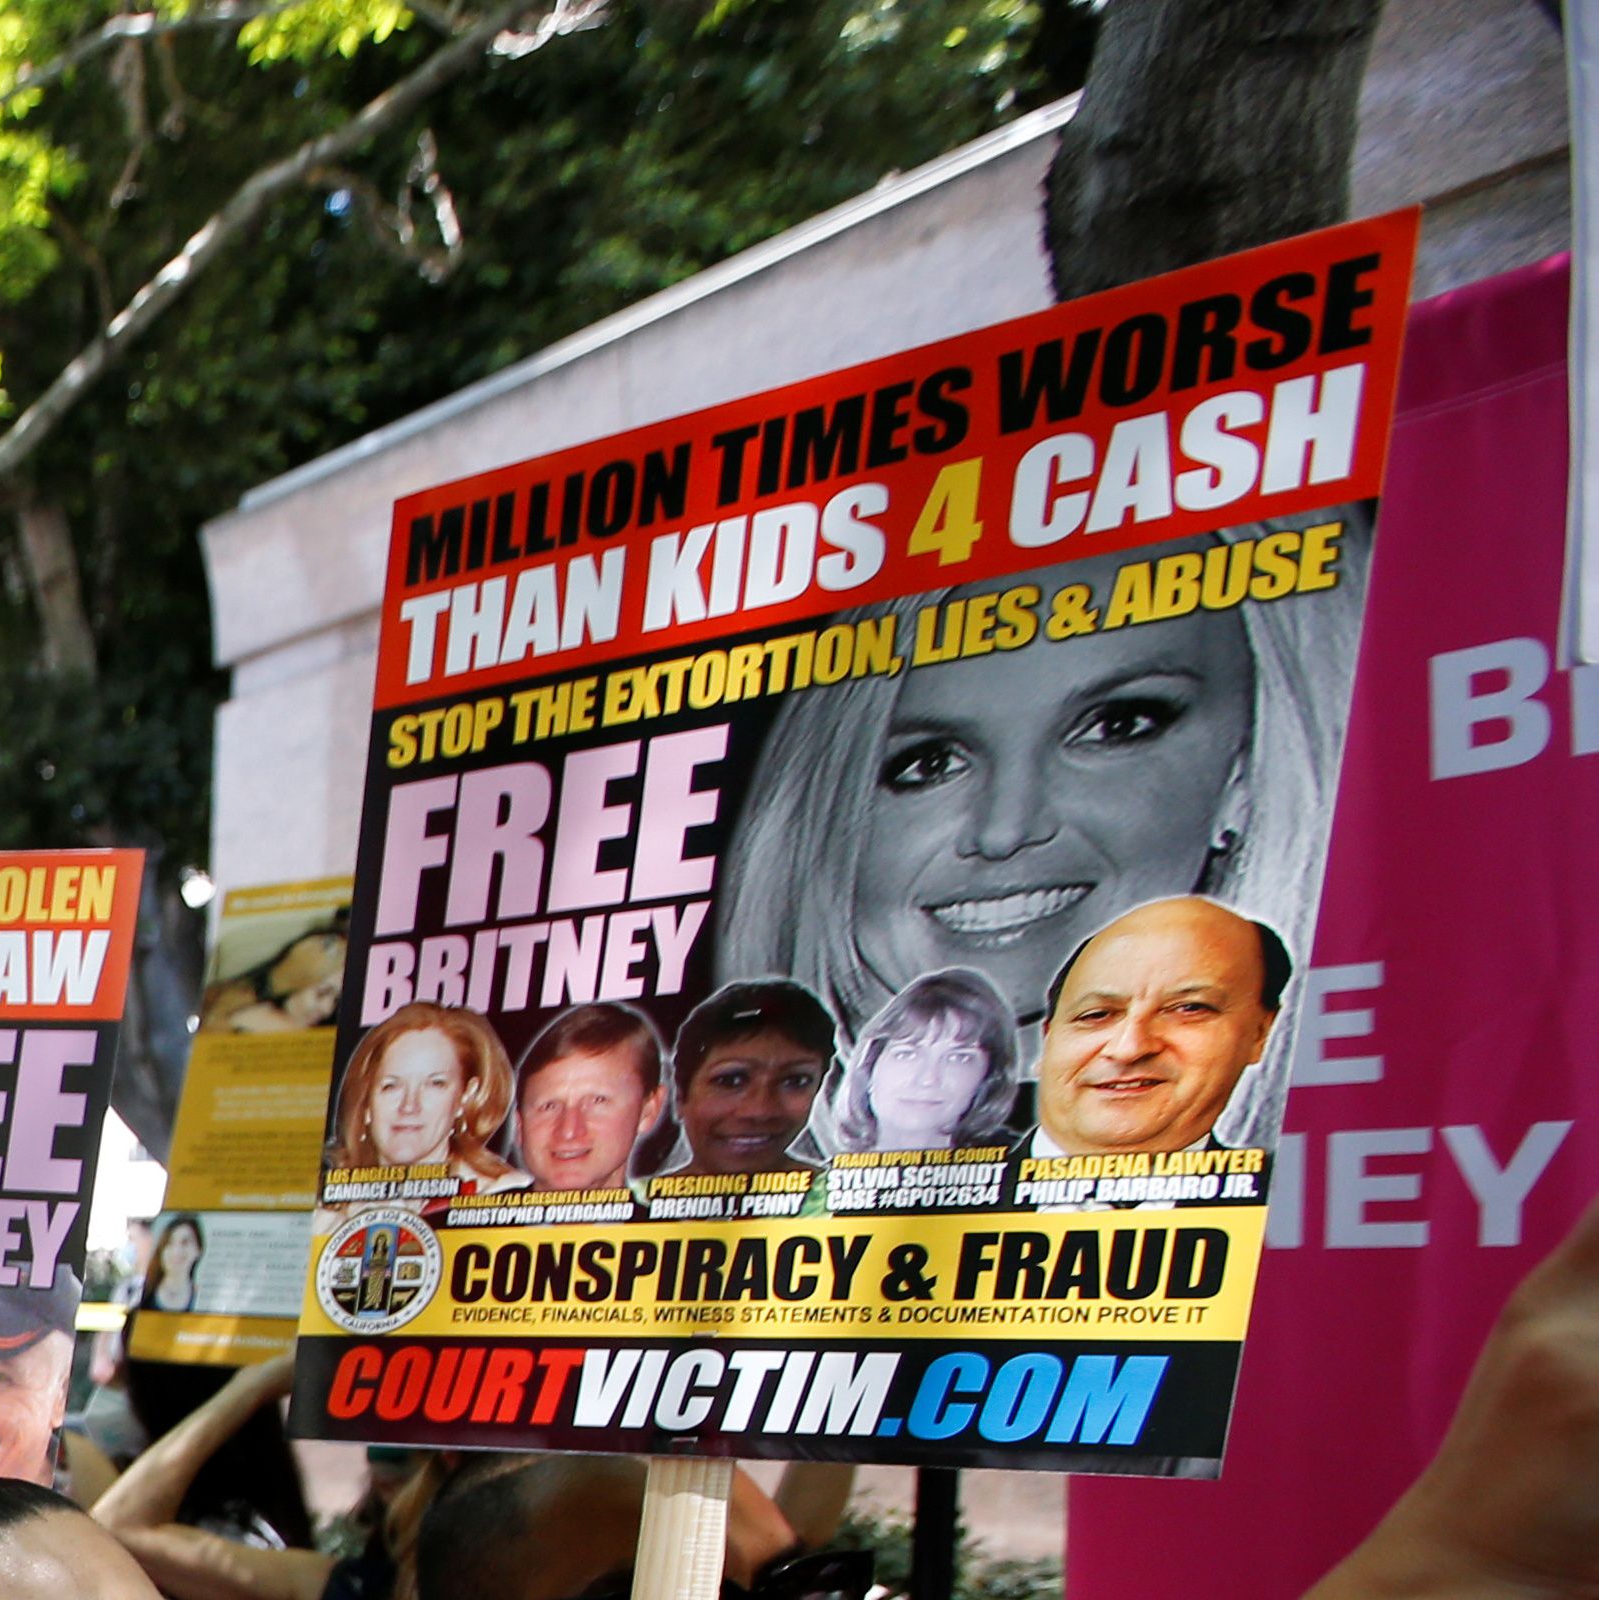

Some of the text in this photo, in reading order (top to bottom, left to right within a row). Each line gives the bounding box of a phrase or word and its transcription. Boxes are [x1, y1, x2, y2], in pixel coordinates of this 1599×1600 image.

[404, 252, 1380, 586] MILLION TIMES WORSE
[400, 363, 1365, 686] THAN KIDS 4 CASH
[386, 521, 1344, 769] STOP THE EXTORTION, LIES & ABUSE
[1428, 636, 1599, 782] B
[372, 724, 730, 938] FREE
[359, 901, 713, 1028] BRITNEY
[833, 1146, 1009, 1168] FRAUD UPON THE COURT
[1018, 1148, 1265, 1182] PASADENA LAWYER
[326, 1163, 449, 1183] LOS ANGELES JUDGE
[649, 1170, 812, 1198] PRESIDING JUDGE
[825, 1163, 1008, 1191] SYLVIA SCHMIDT
[323, 1181, 387, 1201] CANDACE
[403, 1177, 460, 1198] BEASON
[581, 1188, 631, 1203] LAWYER
[826, 1189, 879, 1211] CASE
[1014, 1173, 1259, 1205] PHILIP BARBARO JR.
[446, 1202, 635, 1227] CHRISTOPHER OVERGAARD
[648, 1197, 724, 1219] BRENDA
[741, 1193, 804, 1217] PENNY
[450, 1227, 1230, 1303] CONSPIRACY & FRAUD
[341, 1317, 401, 1331] CALIFORNIA
[451, 1305, 1210, 1326] EVIDENCE, FINANCIALS, WITNESS STATEMENTS & DOCUMENTATION PROVE IT
[327, 1350, 1171, 1446] COURTVICTIM.COM
